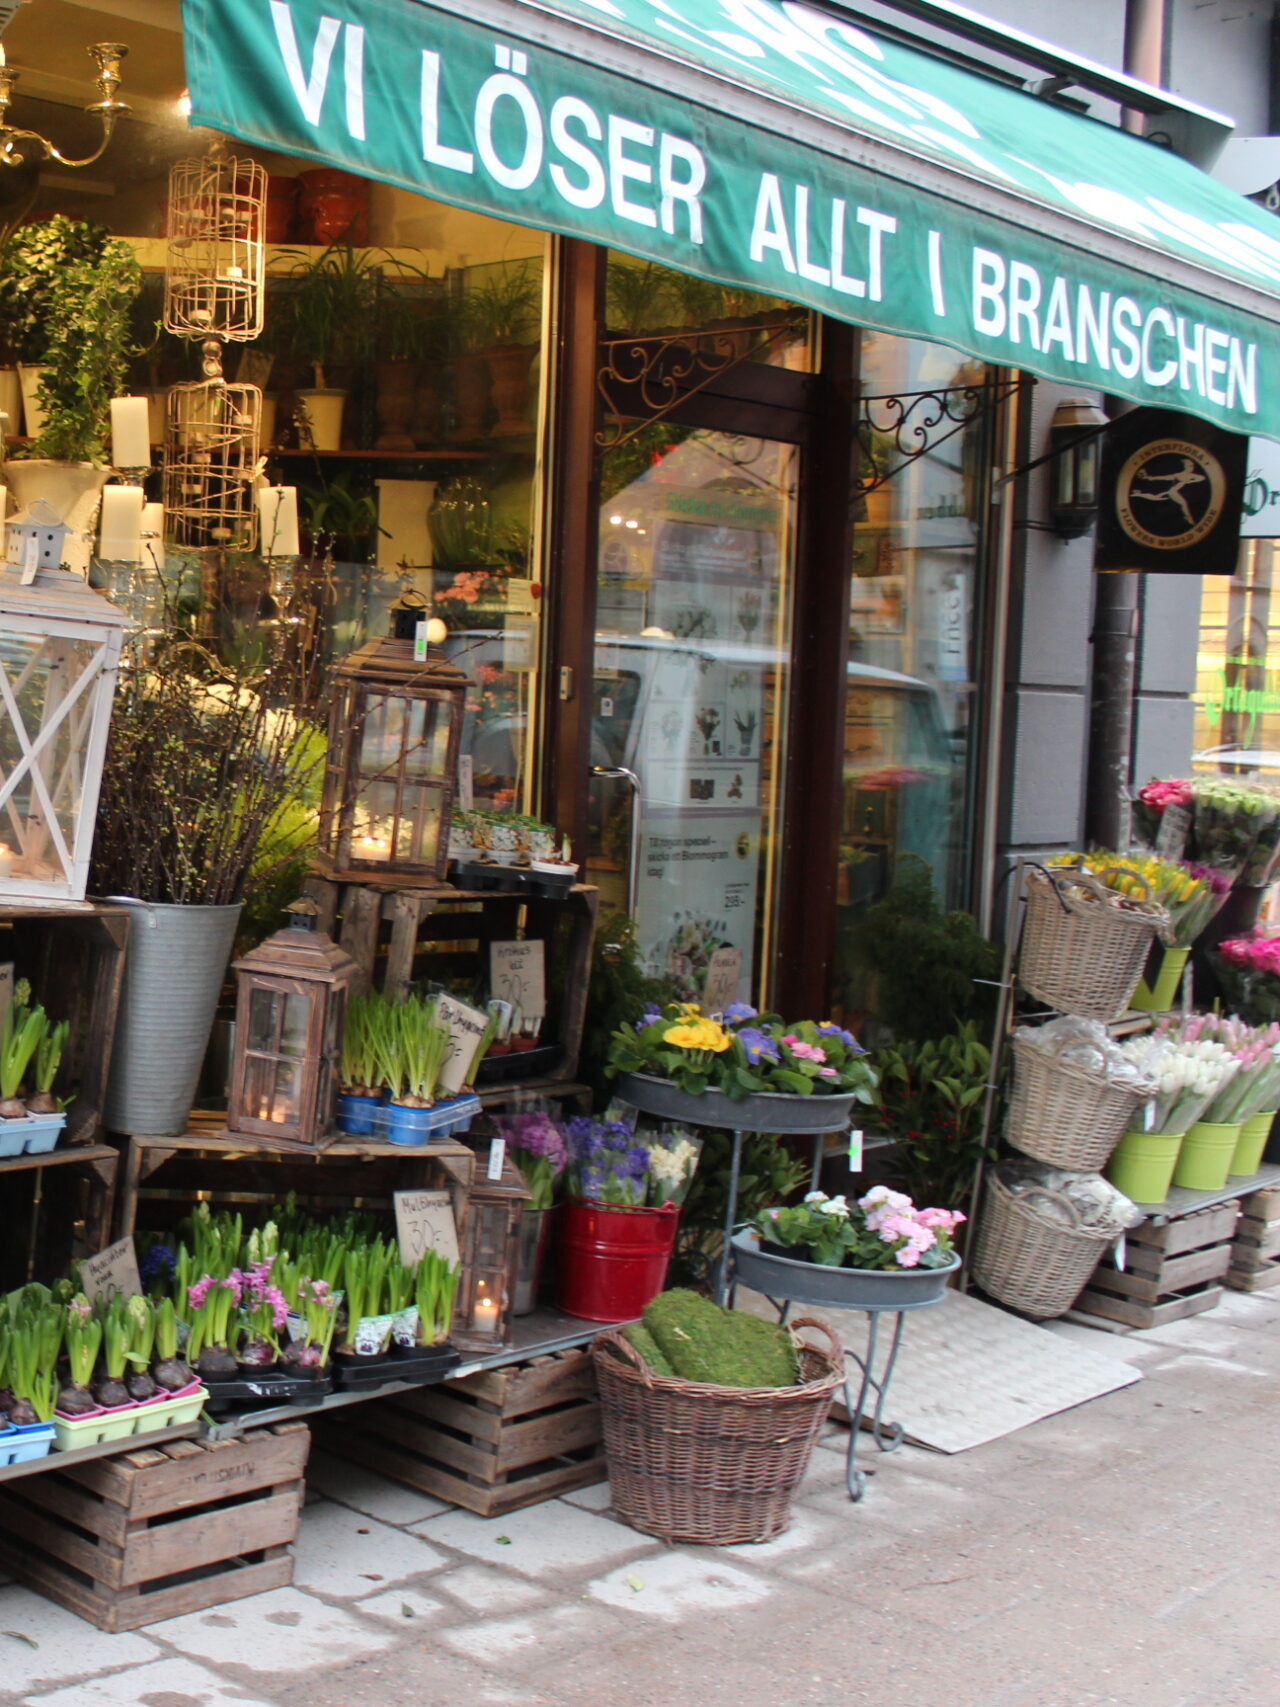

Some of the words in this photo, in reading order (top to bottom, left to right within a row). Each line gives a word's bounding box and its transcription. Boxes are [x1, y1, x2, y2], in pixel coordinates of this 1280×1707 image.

[269, 0, 366, 141] VI
[421, 43, 707, 244] LÖSER
[749, 172, 897, 302] ALLT
[928, 230, 946, 317] I
[972, 246, 1257, 415] BRANSCHEN
[1139, 443, 1205, 462] INTERFLORA
